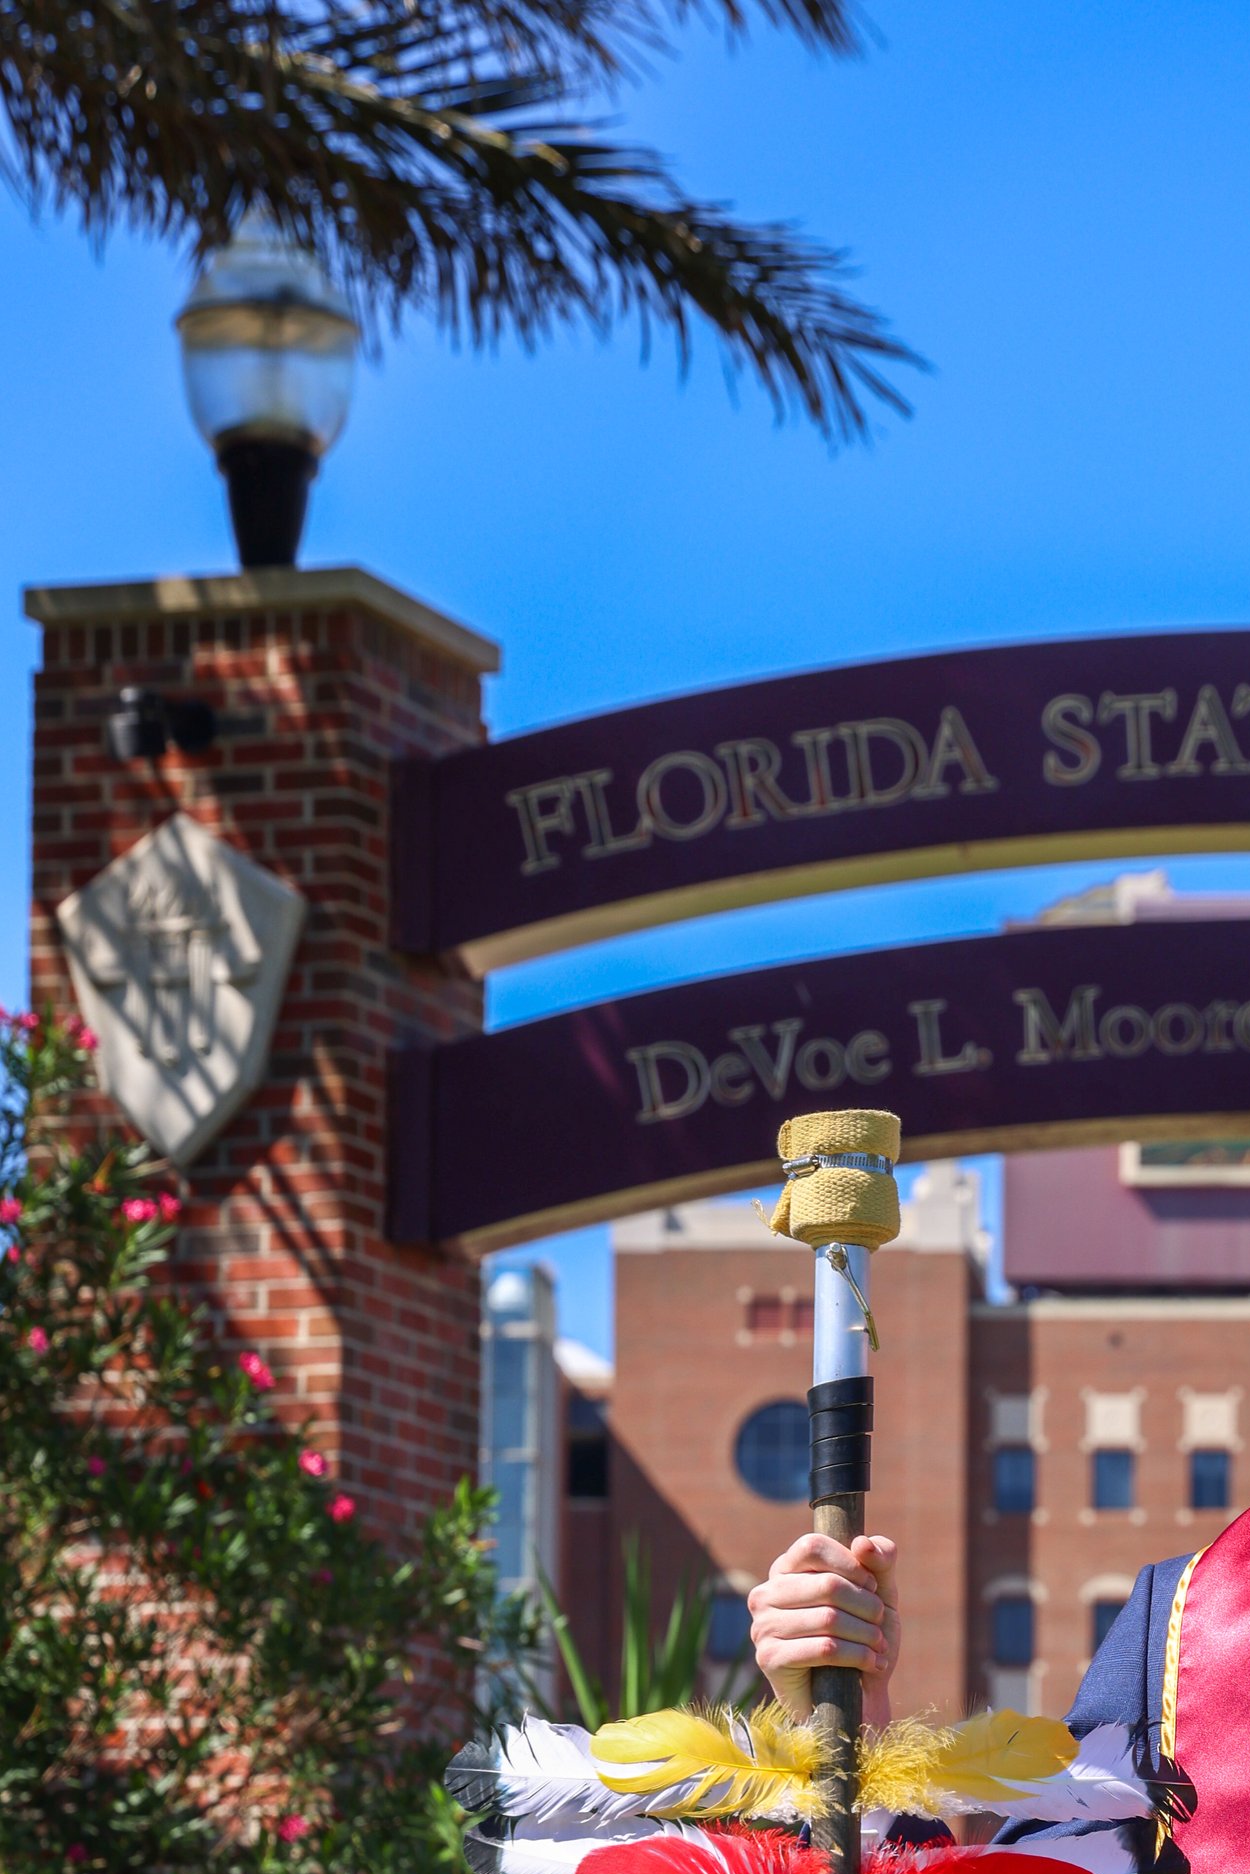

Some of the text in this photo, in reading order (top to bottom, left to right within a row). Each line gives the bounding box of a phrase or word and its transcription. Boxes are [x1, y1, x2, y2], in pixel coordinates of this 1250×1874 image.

[505, 705, 999, 876] FLORIDA
[627, 1016, 893, 1126] DeVoe
[908, 999, 991, 1078] L.
